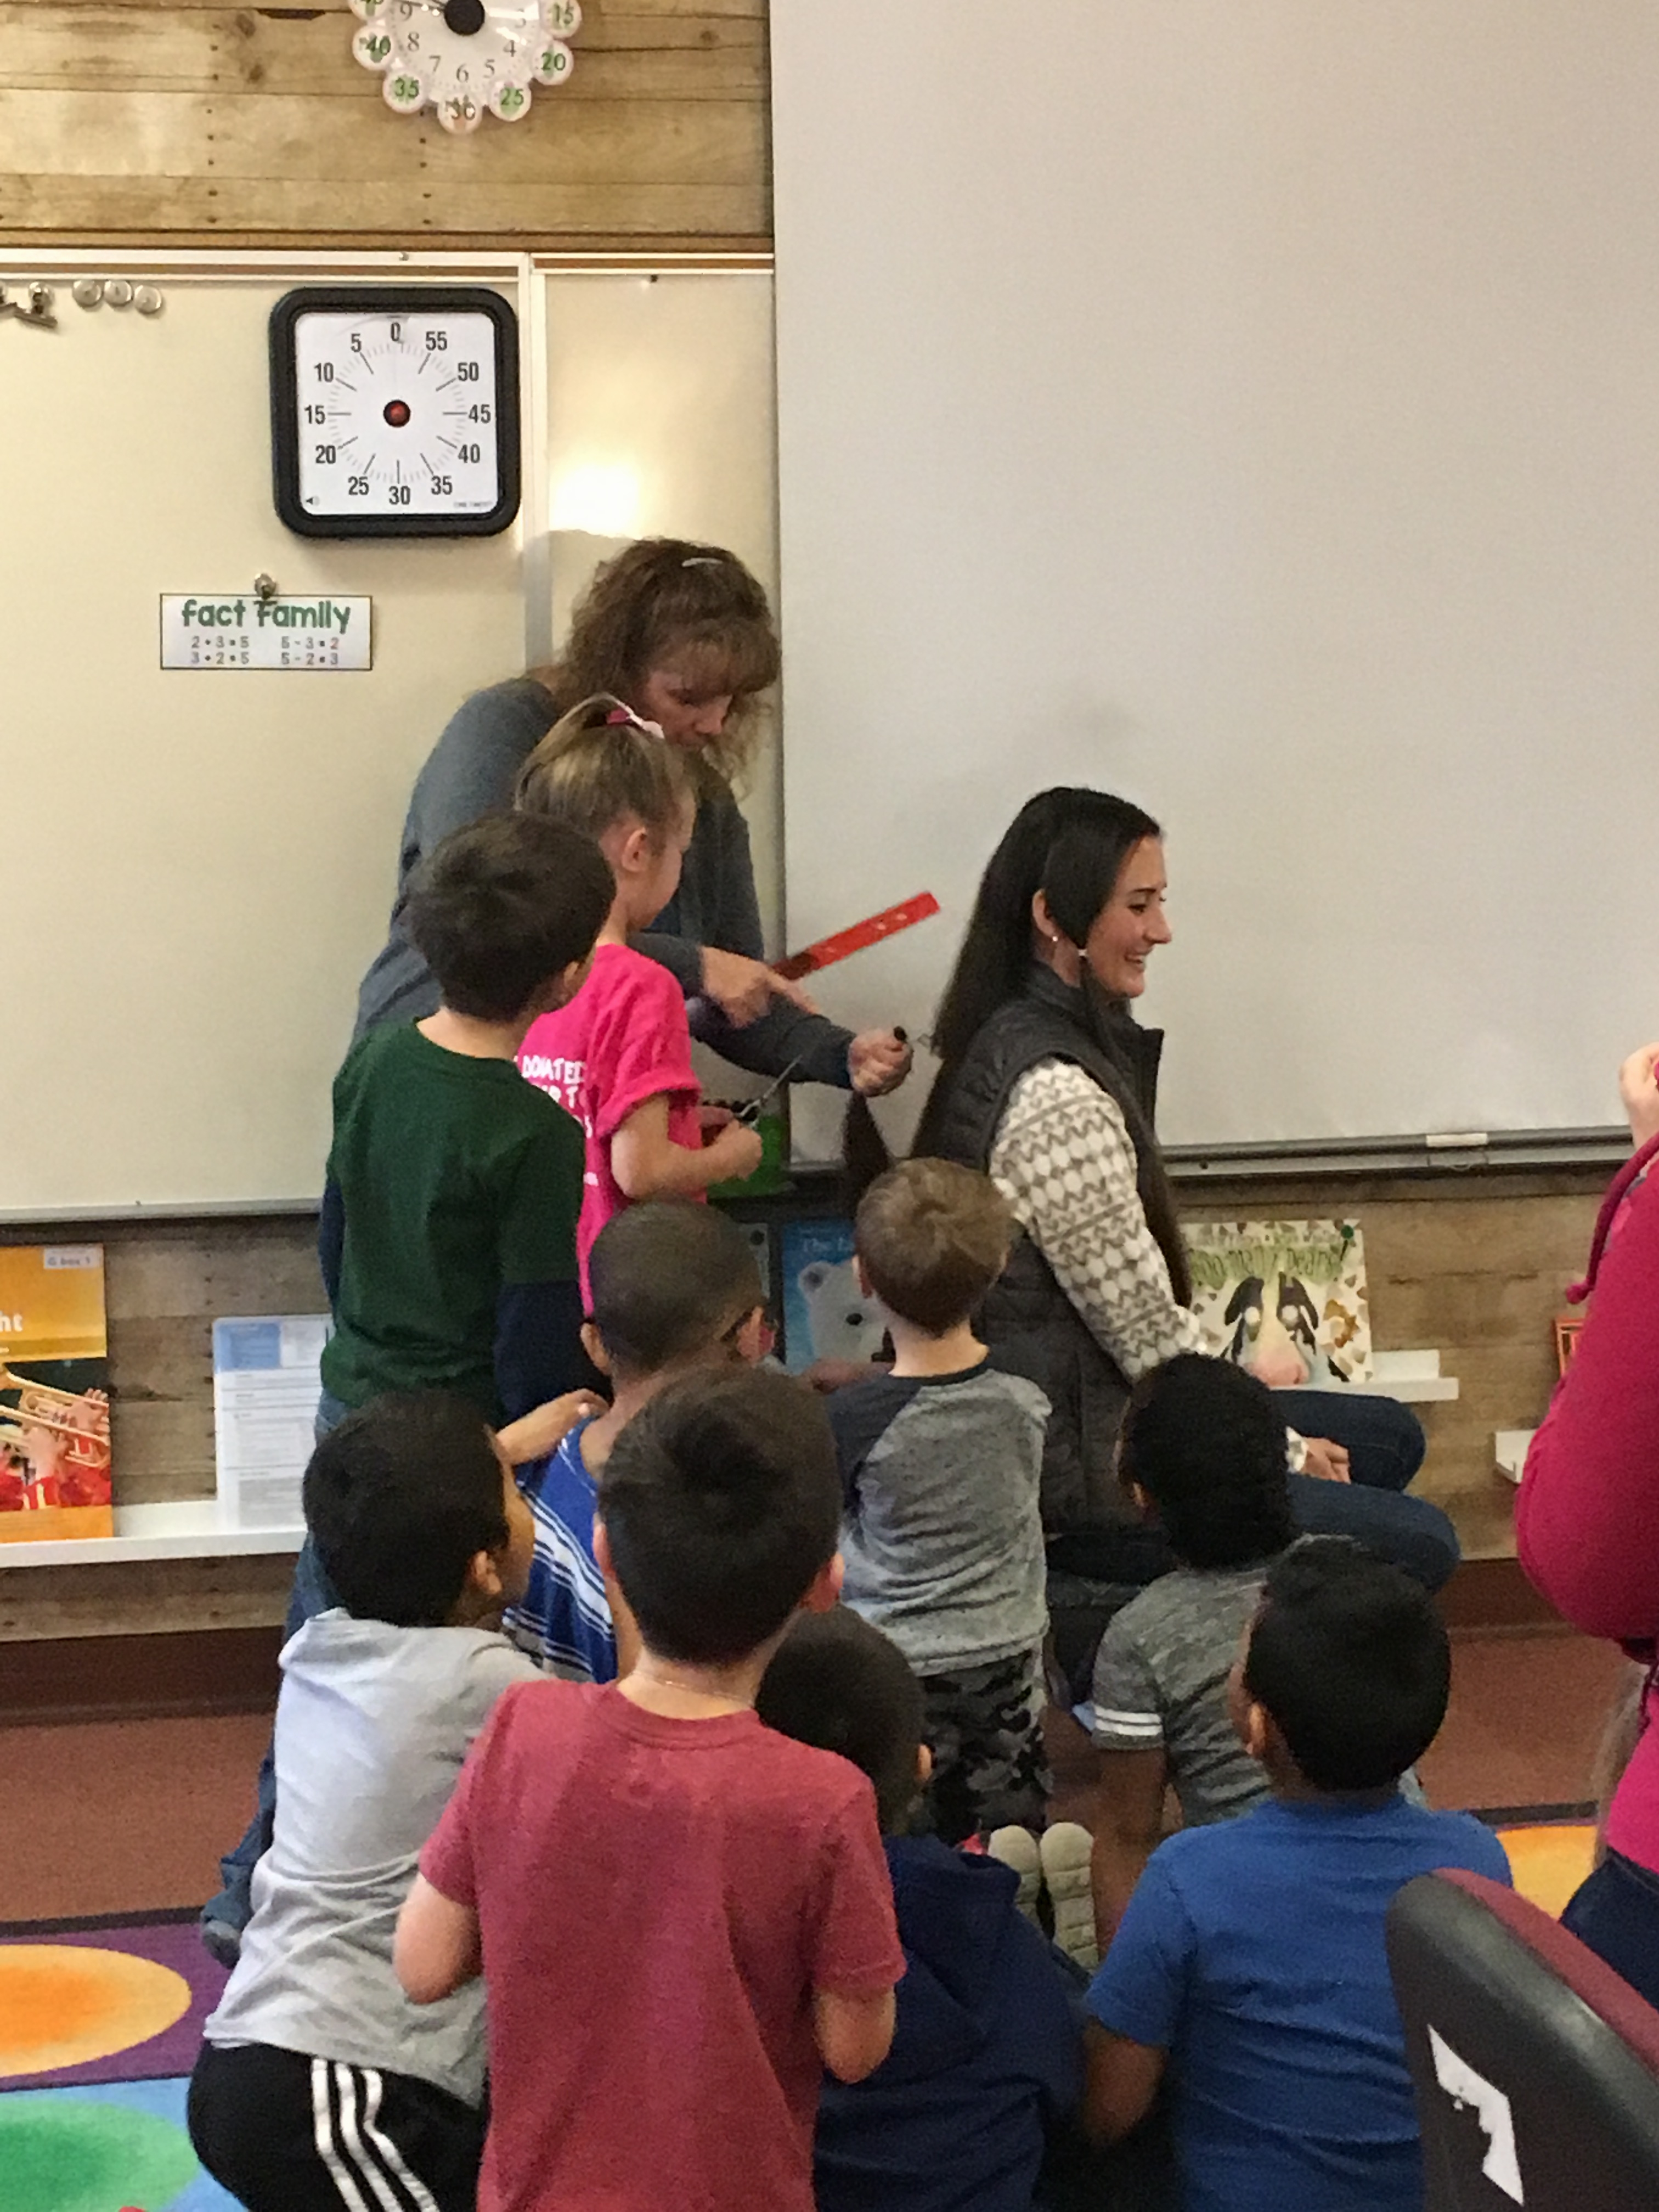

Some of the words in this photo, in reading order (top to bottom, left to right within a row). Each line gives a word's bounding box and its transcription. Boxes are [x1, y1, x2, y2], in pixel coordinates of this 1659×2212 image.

[554, 3, 574, 25] 15
[366, 35, 391, 55] 40
[408, 31, 420, 52] 8
[503, 40, 517, 57] 4
[429, 55, 441, 72] 7
[483, 60, 495, 78] 5
[541, 52, 566, 71] 20
[456, 64, 469, 83] 6
[394, 77, 420, 98] 35
[501, 88, 524, 106] 25
[390, 322, 400, 341] 0
[426, 331, 448, 351] 55
[351, 333, 362, 352] 5
[314, 362, 334, 382] 10
[458, 362, 479, 381] 50
[304, 404, 326, 425] 15
[469, 404, 491, 424] 45
[315, 444, 336, 464] 20
[458, 444, 481, 464] 40
[348, 476, 369, 495] 25
[431, 476, 453, 495] 35
[388, 486, 410, 505] 30
[182, 599, 246, 627] fact
[191, 636, 200, 649] 2
[216, 636, 224, 648] 3
[240, 636, 249, 649] 5
[306, 636, 314, 650] 3
[330, 637, 339, 650] 2
[191, 652, 199, 664] 3
[216, 652, 224, 665] 2
[240, 652, 249, 665] 5
[306, 653, 314, 665] 2
[330, 653, 338, 665] 3
